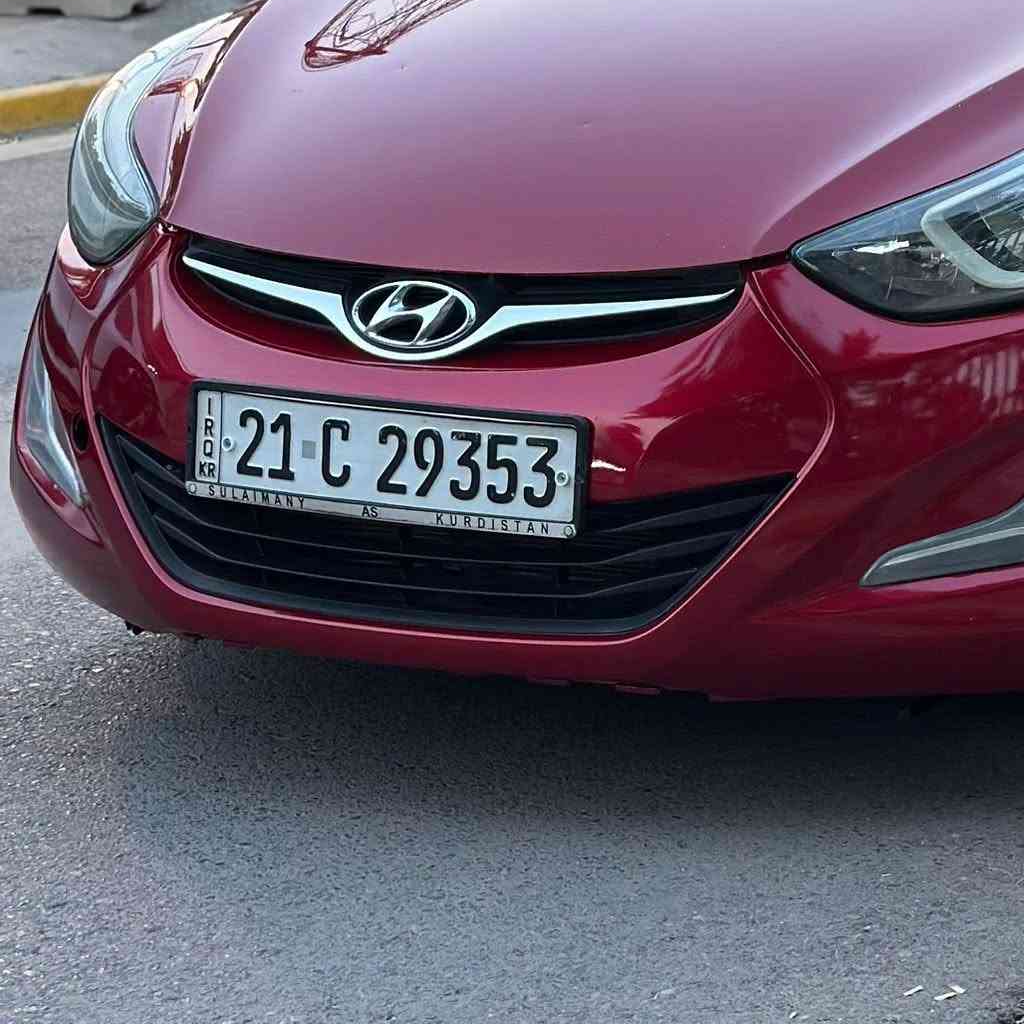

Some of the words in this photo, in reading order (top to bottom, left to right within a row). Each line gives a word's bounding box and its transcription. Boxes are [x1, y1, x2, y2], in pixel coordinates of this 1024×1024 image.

[198, 460, 217, 478] KR
[236, 408, 295, 482] 21
[321, 418, 352, 488] C
[376, 424, 558, 509] 29353
[208, 484, 306, 510] SULAIMANY
[360, 506, 379, 519] AS
[435, 513, 551, 536] KURDISTAN
